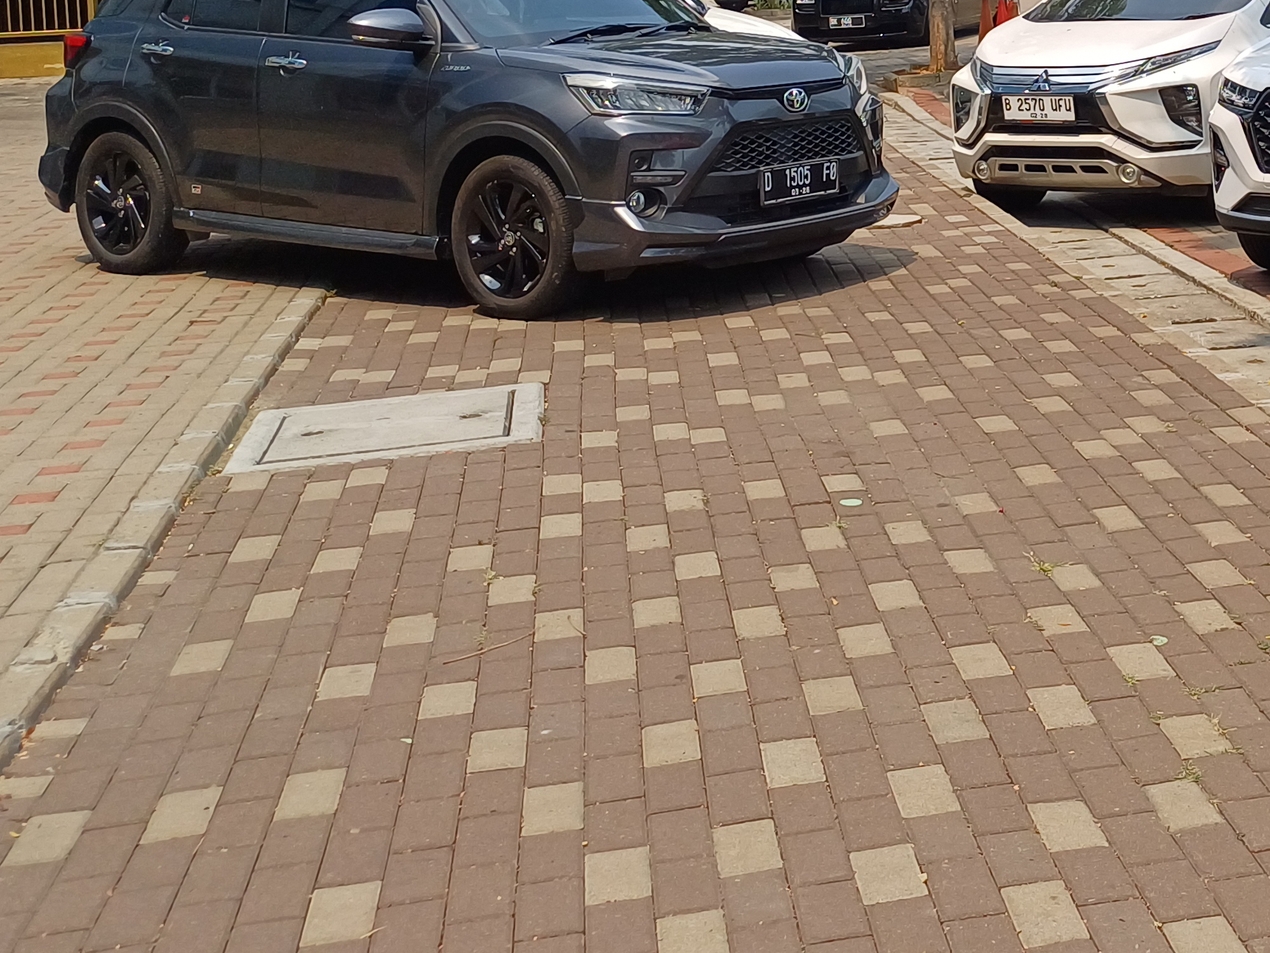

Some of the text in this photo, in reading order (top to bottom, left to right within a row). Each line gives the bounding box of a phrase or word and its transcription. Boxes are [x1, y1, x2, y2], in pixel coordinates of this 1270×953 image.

[1004, 97, 1072, 112] B 2570 UFU
[764, 171, 772, 191] D
[785, 165, 811, 188] 1505
